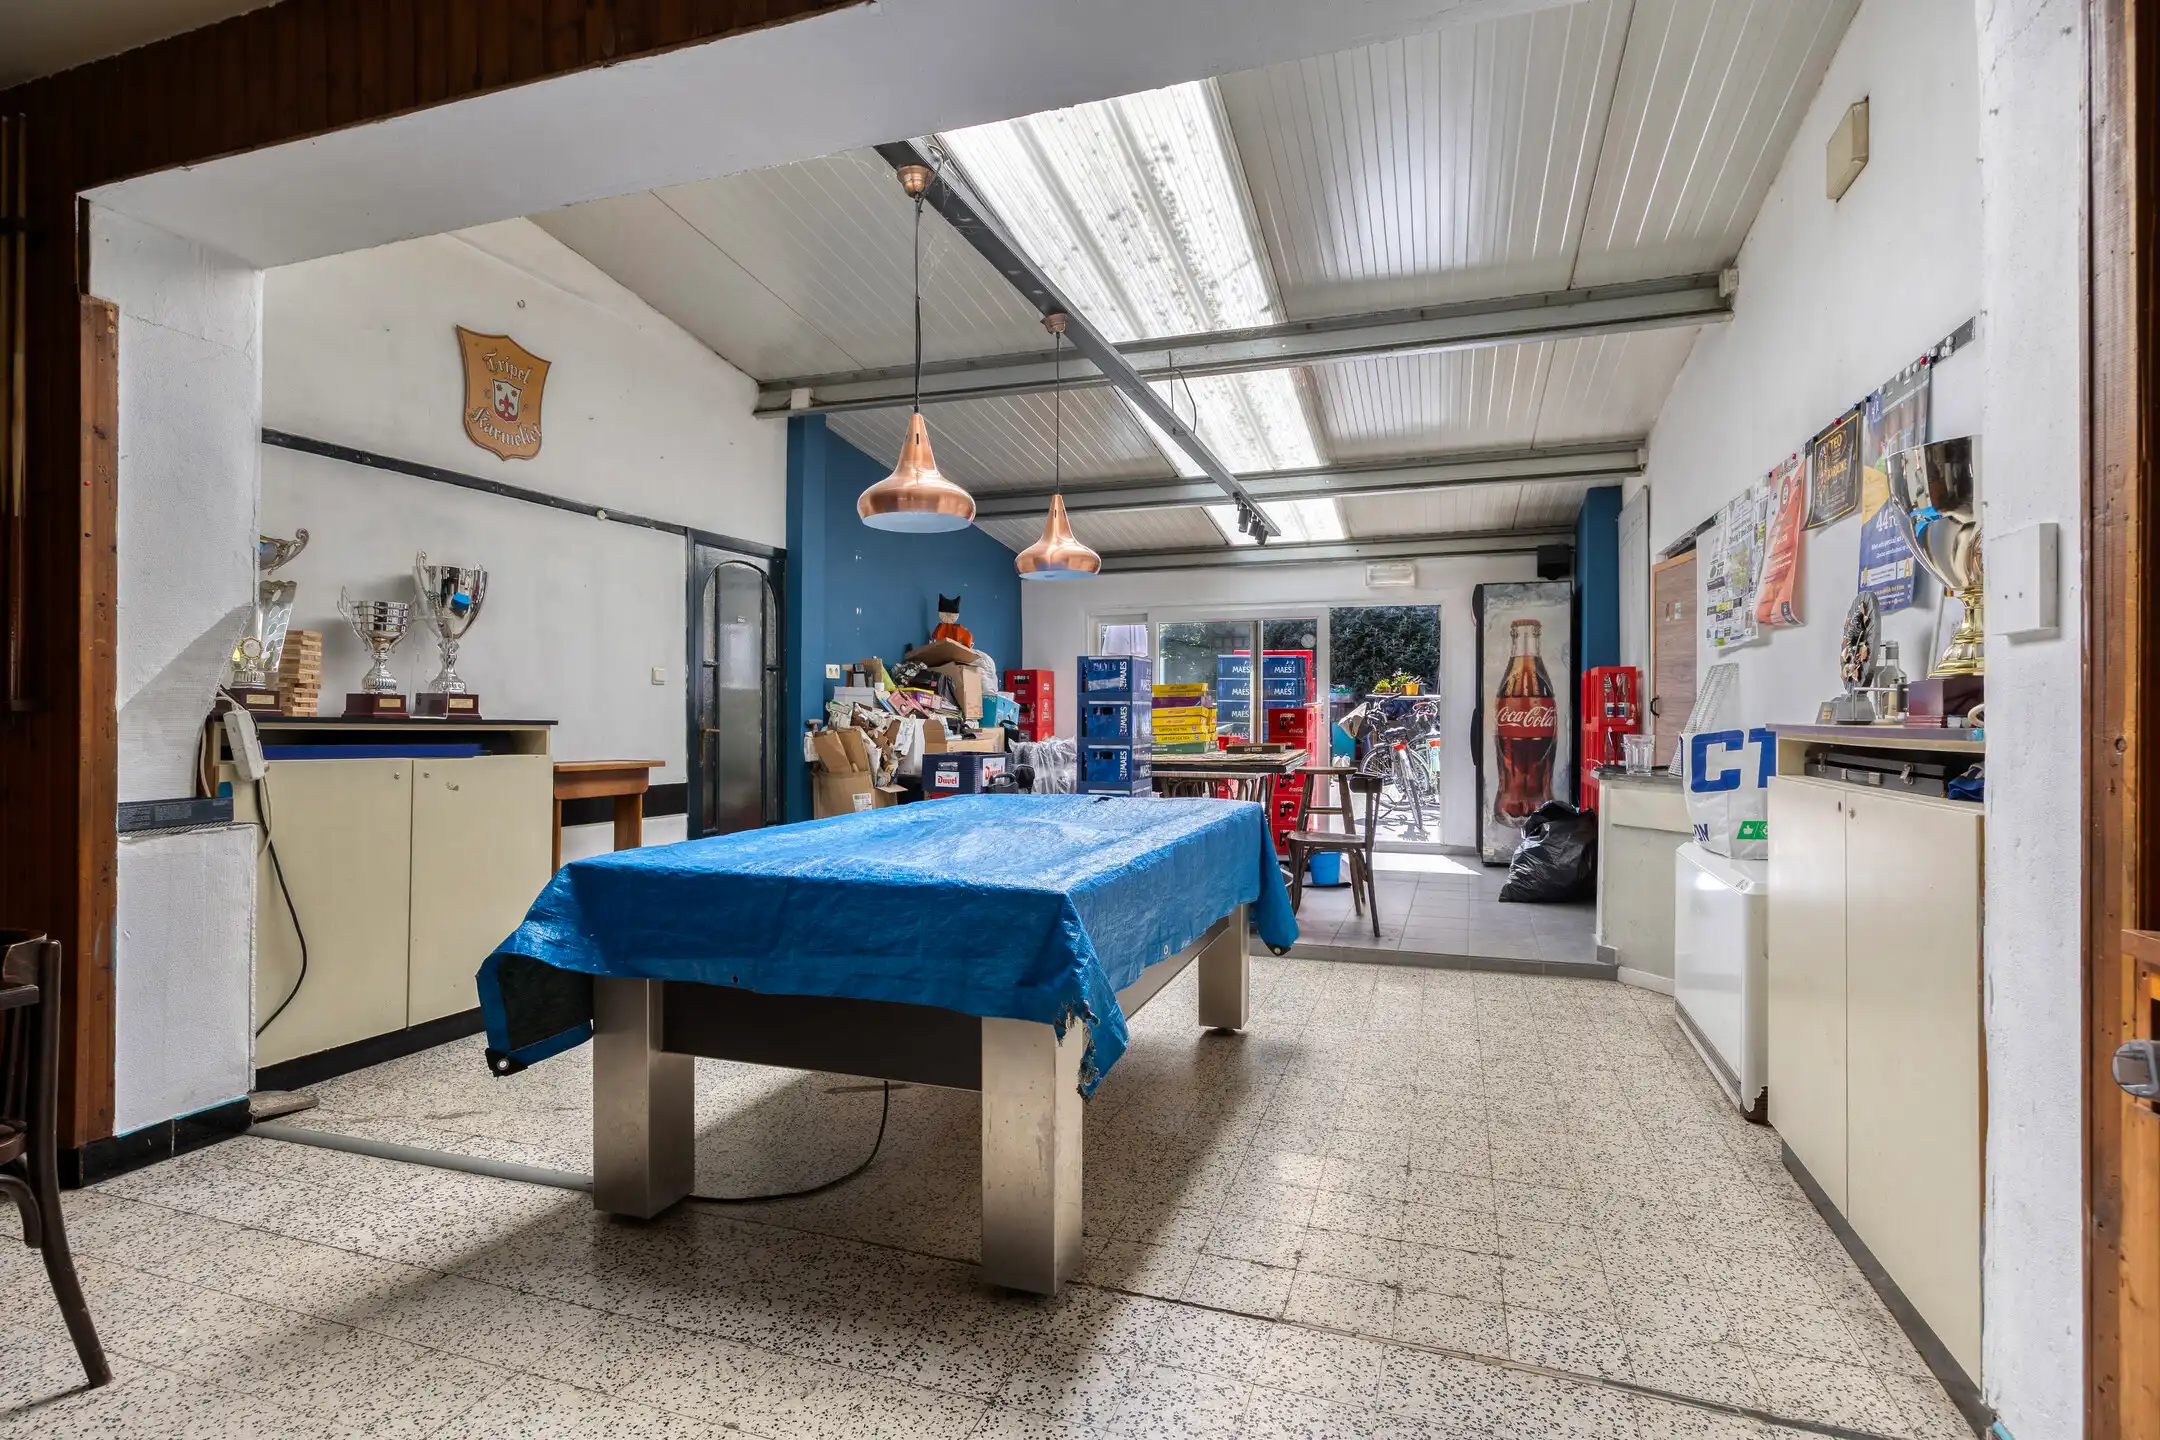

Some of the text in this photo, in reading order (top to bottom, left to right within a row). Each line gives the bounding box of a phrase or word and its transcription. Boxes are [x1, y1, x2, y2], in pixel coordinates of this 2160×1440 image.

[482, 347, 533, 385] Tripel
[469, 406, 544, 446] Karmeliet
[1119, 661, 1128, 681] MAES
[1119, 706, 1128, 726] MAES
[1231, 710, 1249, 718] MAES
[1119, 751, 1128, 771] MAES
[937, 775, 957, 785] Duvel
